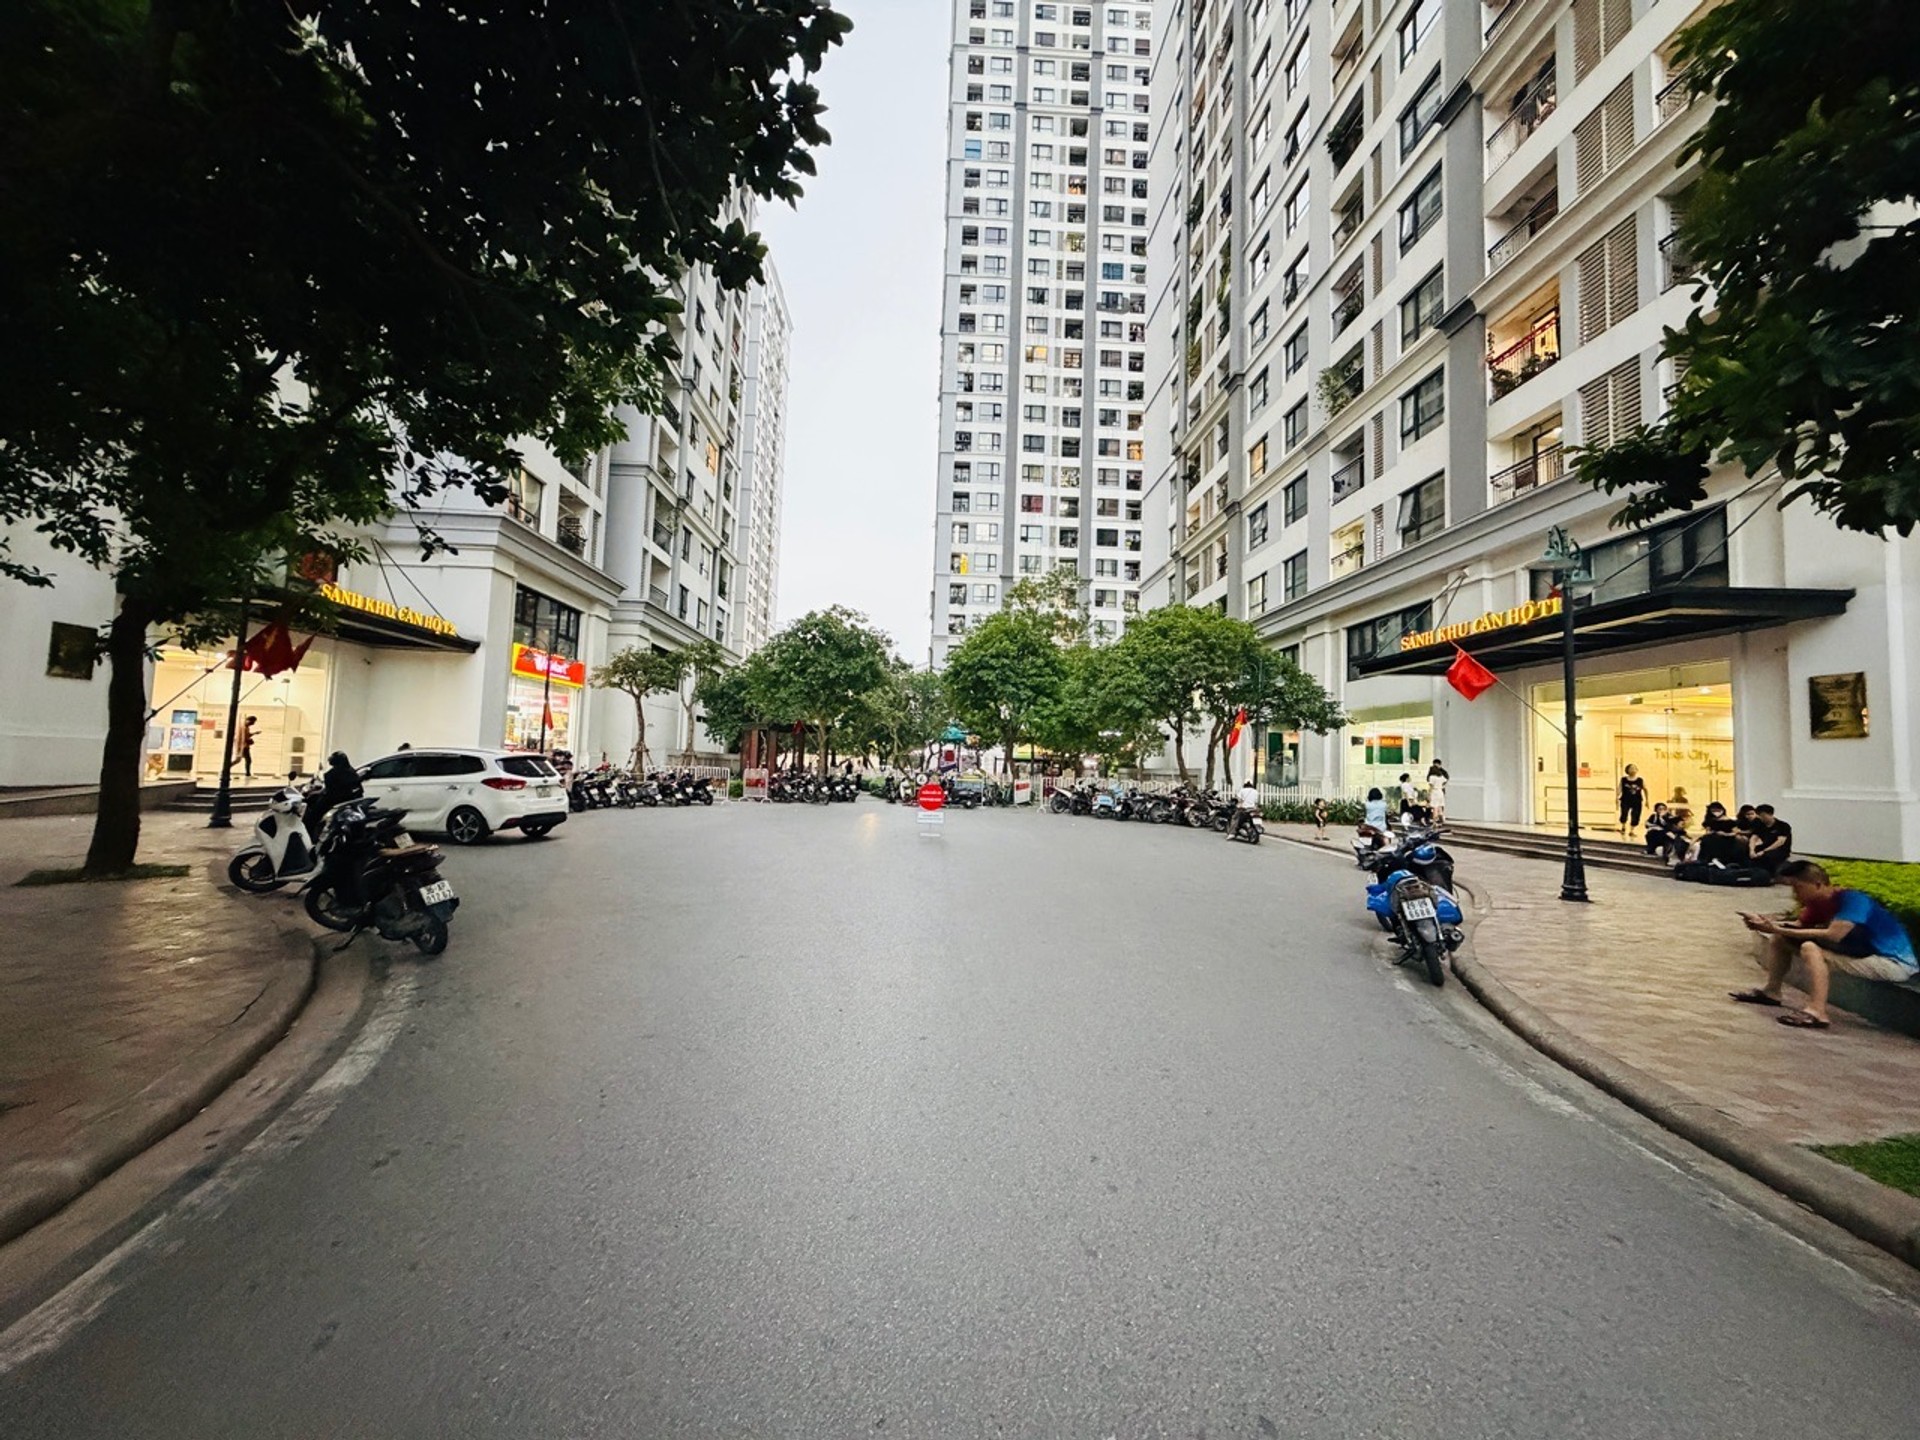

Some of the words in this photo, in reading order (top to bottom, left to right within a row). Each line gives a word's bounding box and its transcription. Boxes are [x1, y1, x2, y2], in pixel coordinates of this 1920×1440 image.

[364, 597, 397, 619] KHU
[1438, 621, 1470, 642] KHU
[1472, 611, 1503, 633] CĂN
[1507, 600, 1535, 626] HỘ
